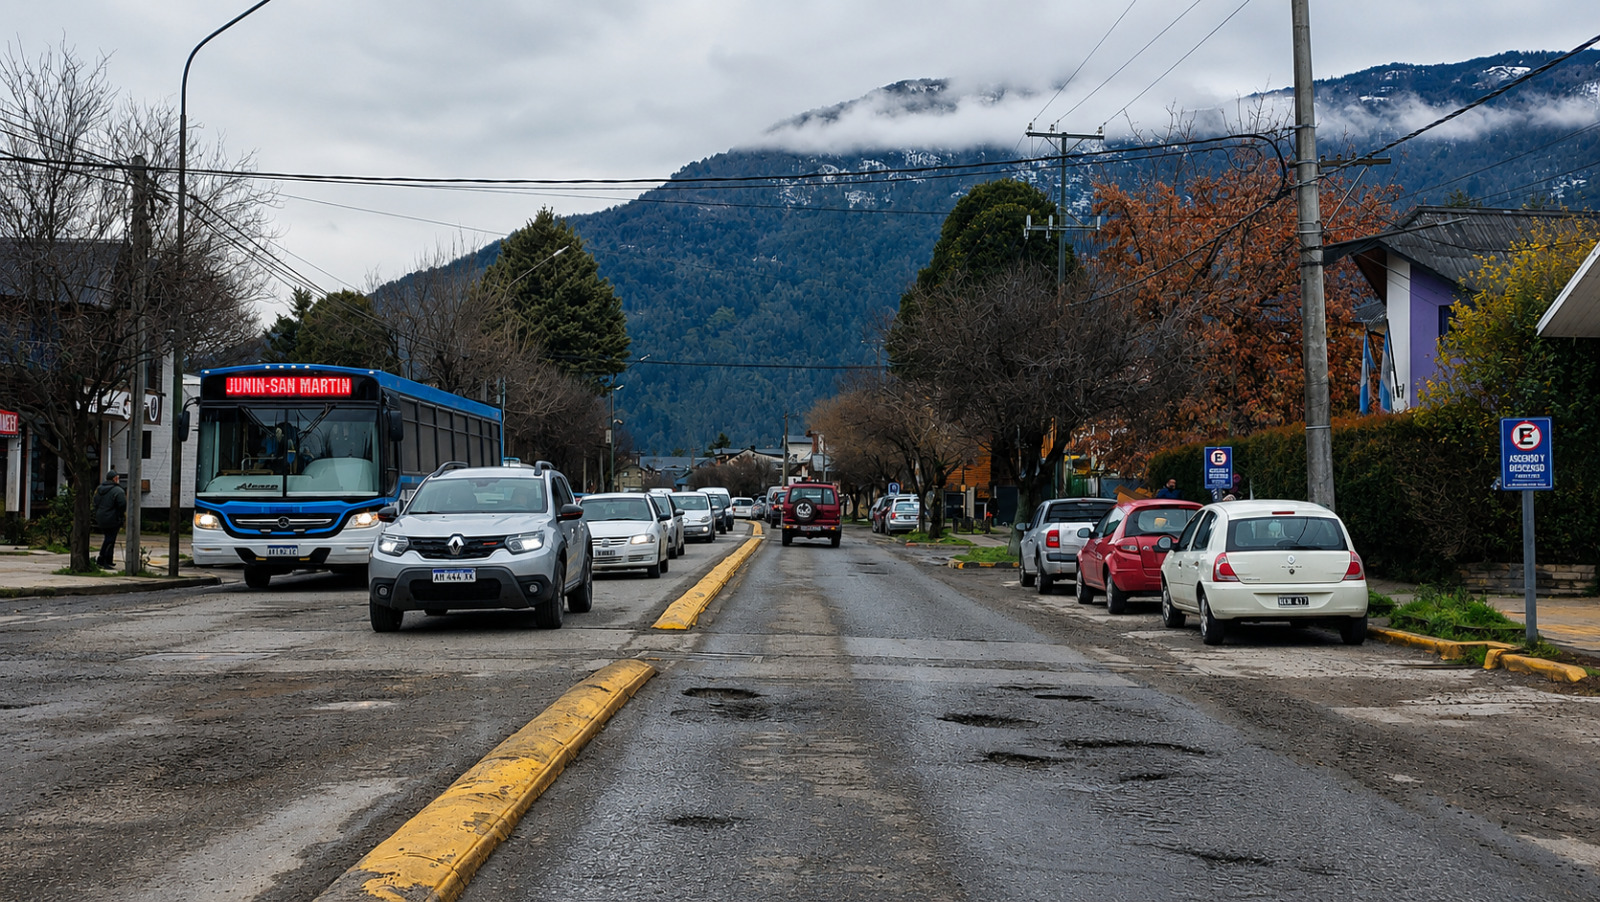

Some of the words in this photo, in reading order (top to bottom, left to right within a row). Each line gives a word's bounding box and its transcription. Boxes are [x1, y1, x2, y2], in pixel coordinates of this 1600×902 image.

[226, 378, 296, 393] JUNIN-SAN
[300, 378, 350, 393] MARTIN
[1519, 428, 1534, 445] E
[1214, 453, 1224, 463] E
[1540, 454, 1545, 462] Y
